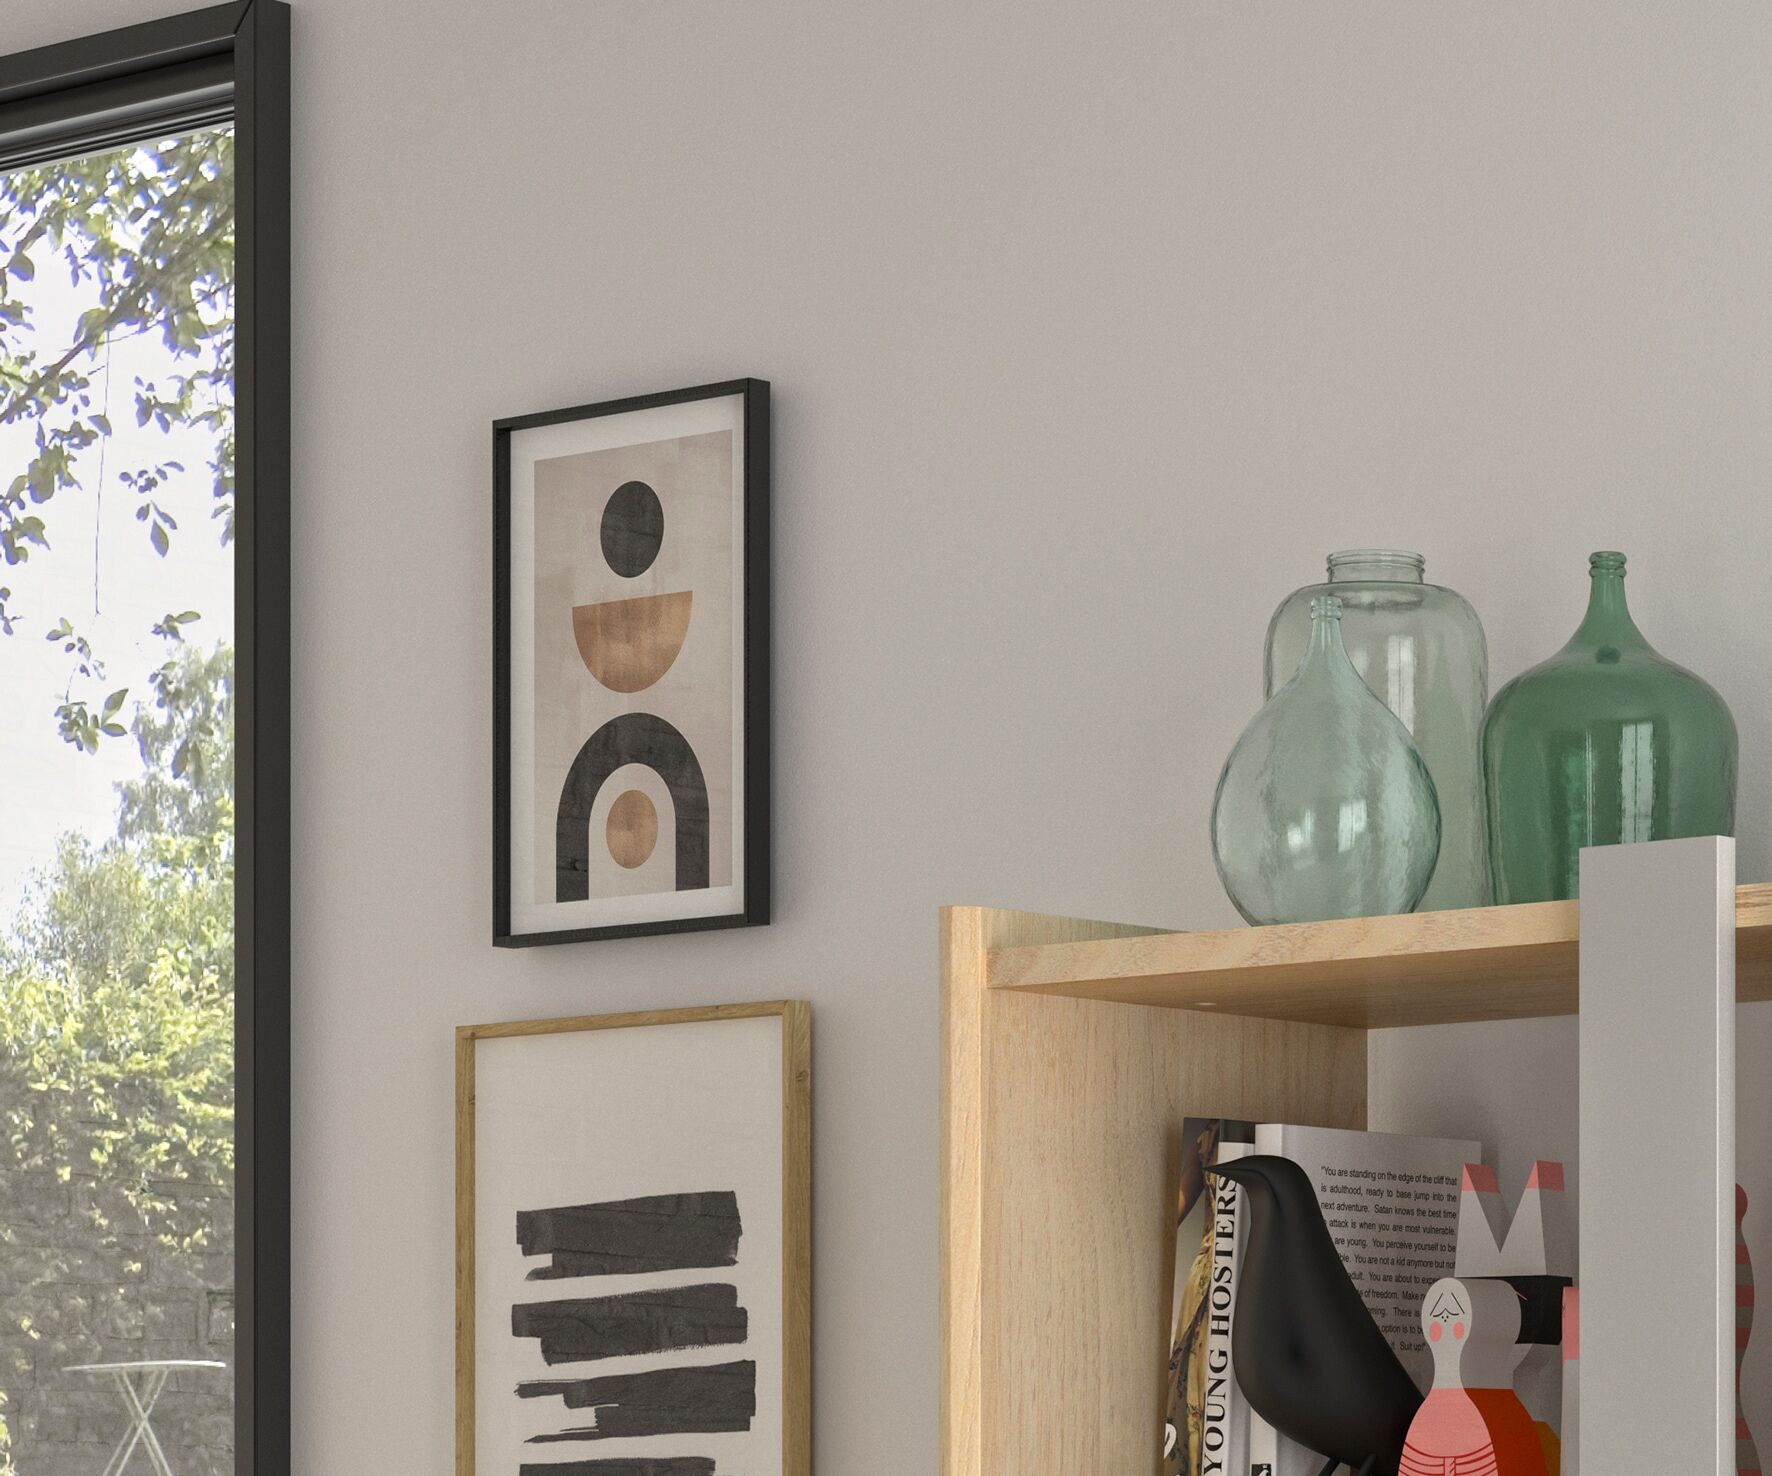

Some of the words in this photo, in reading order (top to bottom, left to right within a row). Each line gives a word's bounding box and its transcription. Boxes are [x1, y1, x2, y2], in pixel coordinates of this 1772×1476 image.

[1338, 1169, 1348, 1177] are
[1349, 1168, 1376, 1180] standing
[1377, 1172, 1386, 1180] on
[1386, 1171, 1397, 1181] the
[1398, 1173, 1414, 1183] edge
[1414, 1174, 1422, 1183] of
[1422, 1174, 1432, 1184] the
[1433, 1175, 1445, 1185] cliff
[1445, 1177, 1457, 1186] that
[1330, 1184, 1363, 1196] adulthood,
[1366, 1188, 1384, 1198] ready
[1396, 1190, 1412, 1199] base
[1414, 1190, 1430, 1201] jump
[1432, 1191, 1444, 1201] into
[1446, 1193, 1457, 1202] the
[1321, 1202, 1335, 1210] next
[1336, 1202, 1370, 1213] adventure.
[1374, 1204, 1393, 1215] Satan
[1394, 1206, 1414, 1216] knows
[1416, 1208, 1426, 1217] the
[1428, 1208, 1442, 1218] best
[1443, 1209, 1457, 1219] time
[1329, 1219, 1348, 1228] attack
[1359, 1221, 1376, 1230] when
[1378, 1224, 1390, 1232] you
[1392, 1224, 1403, 1232] are
[1404, 1224, 1420, 1234] most
[1422, 1225, 1456, 1236] vulnerable.
[1334, 1236, 1344, 1245] are
[1346, 1238, 1368, 1249] young.
[1372, 1238, 1384, 1248] You
[1386, 1240, 1412, 1251] perceive
[1414, 1241, 1438, 1252] yourself
[1211, 1175, 1237, 1338] HOSTERS
[1354, 1254, 1367, 1264] You
[1368, 1256, 1378, 1264] are
[1380, 1256, 1390, 1265] not
[1406, 1259, 1434, 1269] anymore
[1434, 1258, 1444, 1268] but
[1368, 1272, 1380, 1282] You
[1382, 1274, 1393, 1282] are
[1394, 1274, 1412, 1284] about
[1372, 1289, 1400, 1300] freedom.
[1402, 1291, 1419, 1300] Make
[1393, 1307, 1412, 1317] There
[1204, 1348, 1228, 1474] YOUNG
